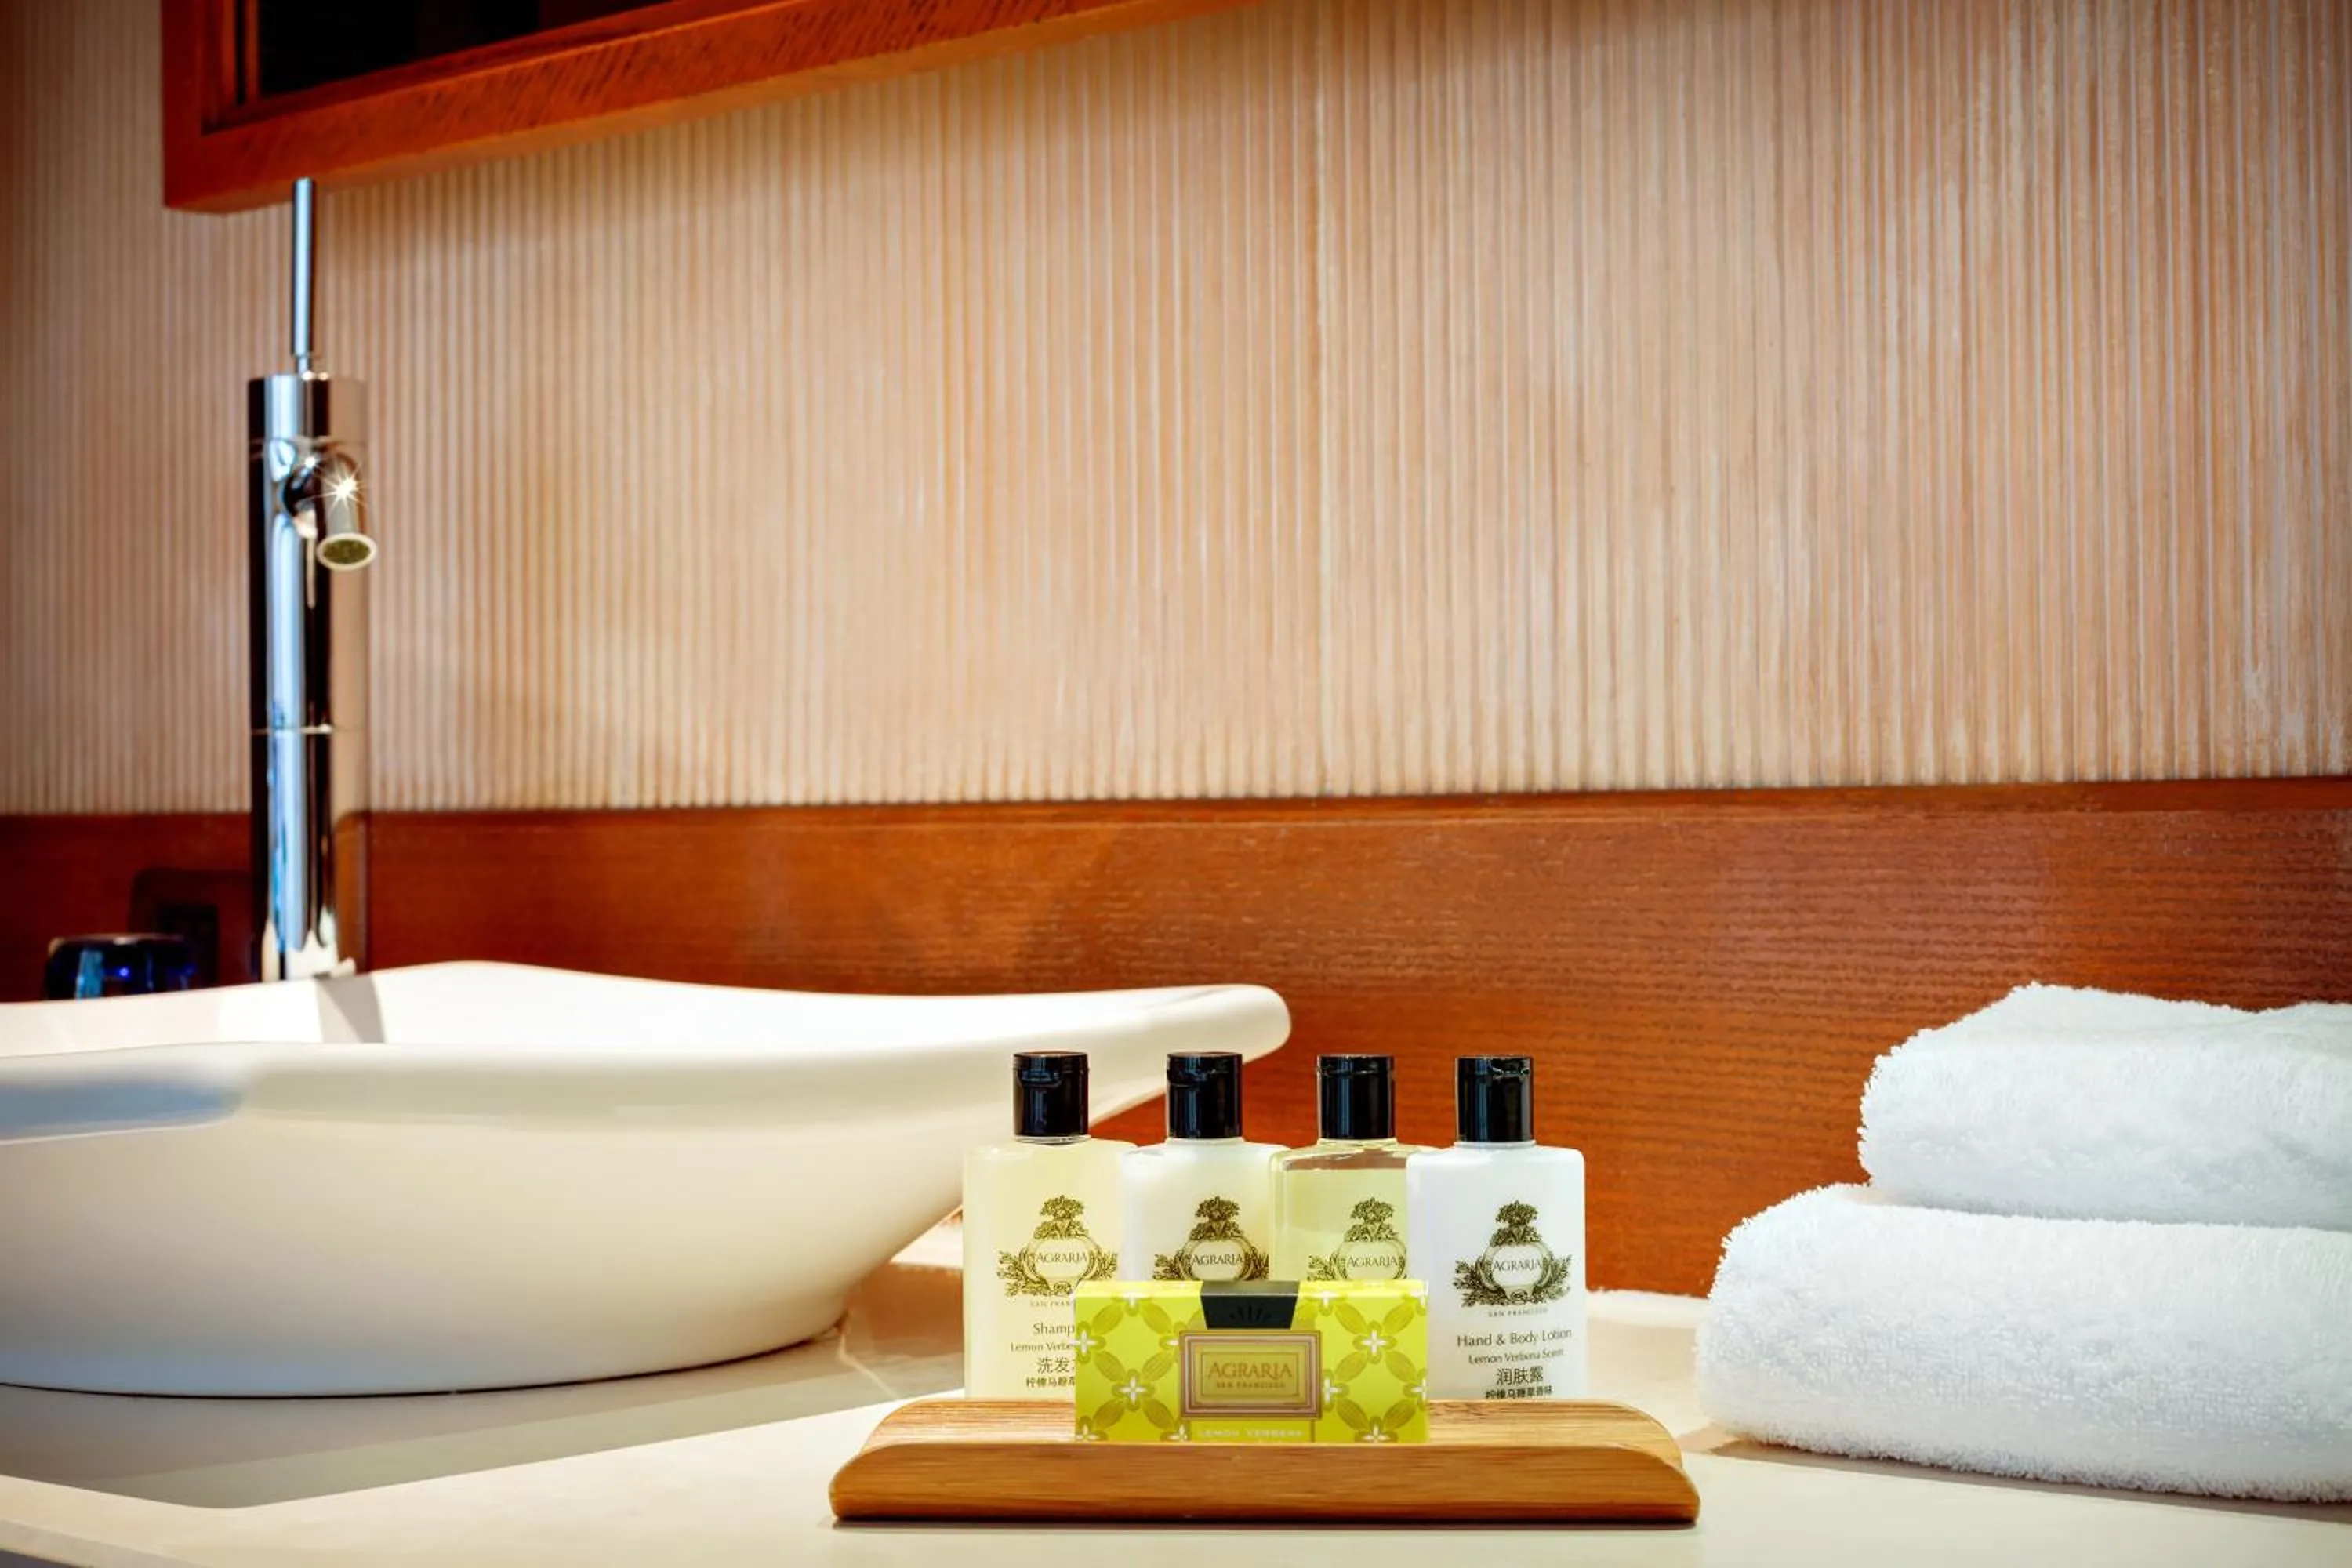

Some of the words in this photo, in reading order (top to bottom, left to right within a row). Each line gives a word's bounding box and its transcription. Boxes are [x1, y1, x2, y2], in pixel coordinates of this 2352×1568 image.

[1036, 1252, 1087, 1264] AGRARIA
[1192, 1254, 1244, 1266] AGRARIA
[1347, 1255, 1398, 1268] AGRARIA
[1492, 1258, 1542, 1271] AGRARIA
[1457, 1334, 1492, 1347] Hand
[1496, 1334, 1505, 1346] &
[1511, 1331, 1538, 1346] Body
[1542, 1328, 1572, 1341] Lotion
[1011, 1341, 1044, 1352] Lemon
[1468, 1354, 1503, 1365] Lemon
[1504, 1351, 1541, 1363] Verbena
[1037, 1356, 1075, 1374] 洗发
[1207, 1362, 1293, 1381] AGRARIA
[1496, 1365, 1544, 1385] 润肤露
